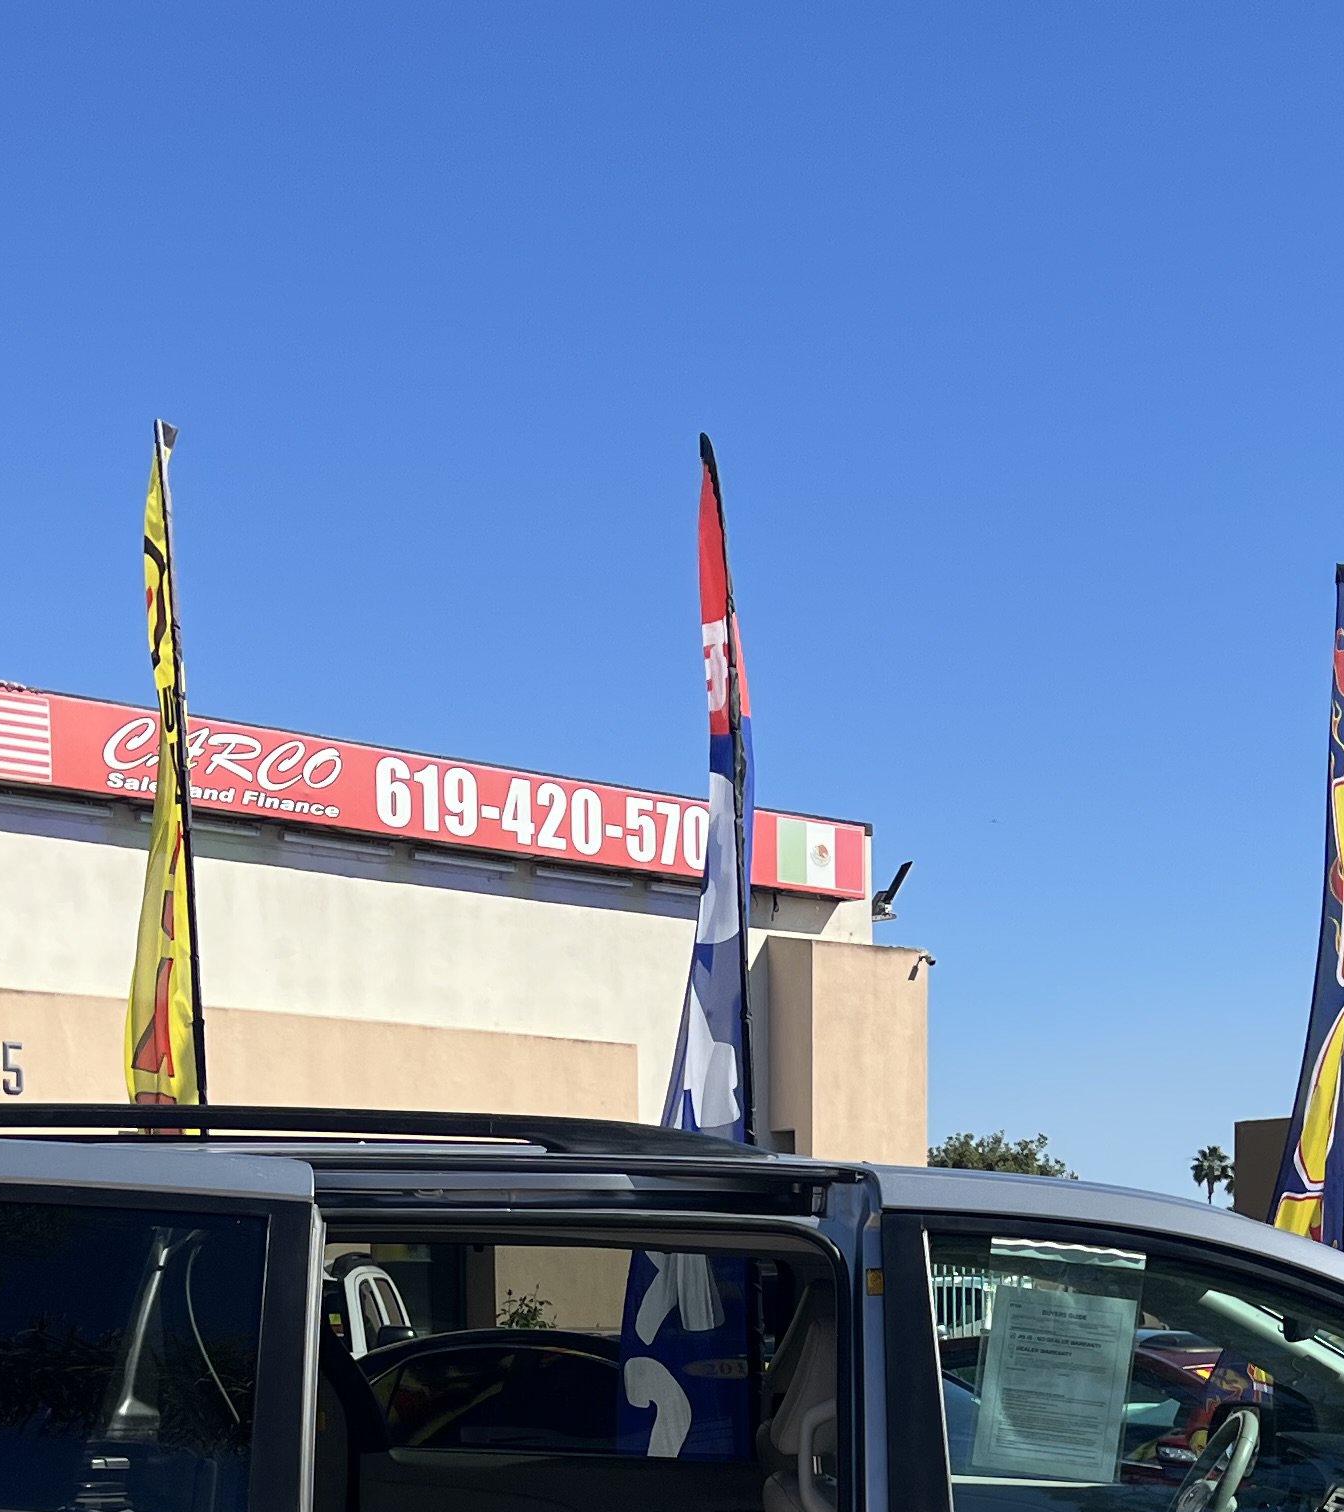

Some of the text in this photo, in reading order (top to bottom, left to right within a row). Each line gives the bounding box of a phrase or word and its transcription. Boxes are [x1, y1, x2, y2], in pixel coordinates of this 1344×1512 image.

[190, 786, 234, 804] and
[242, 790, 341, 818] Finance
[375, 756, 709, 871] 619-420-570
